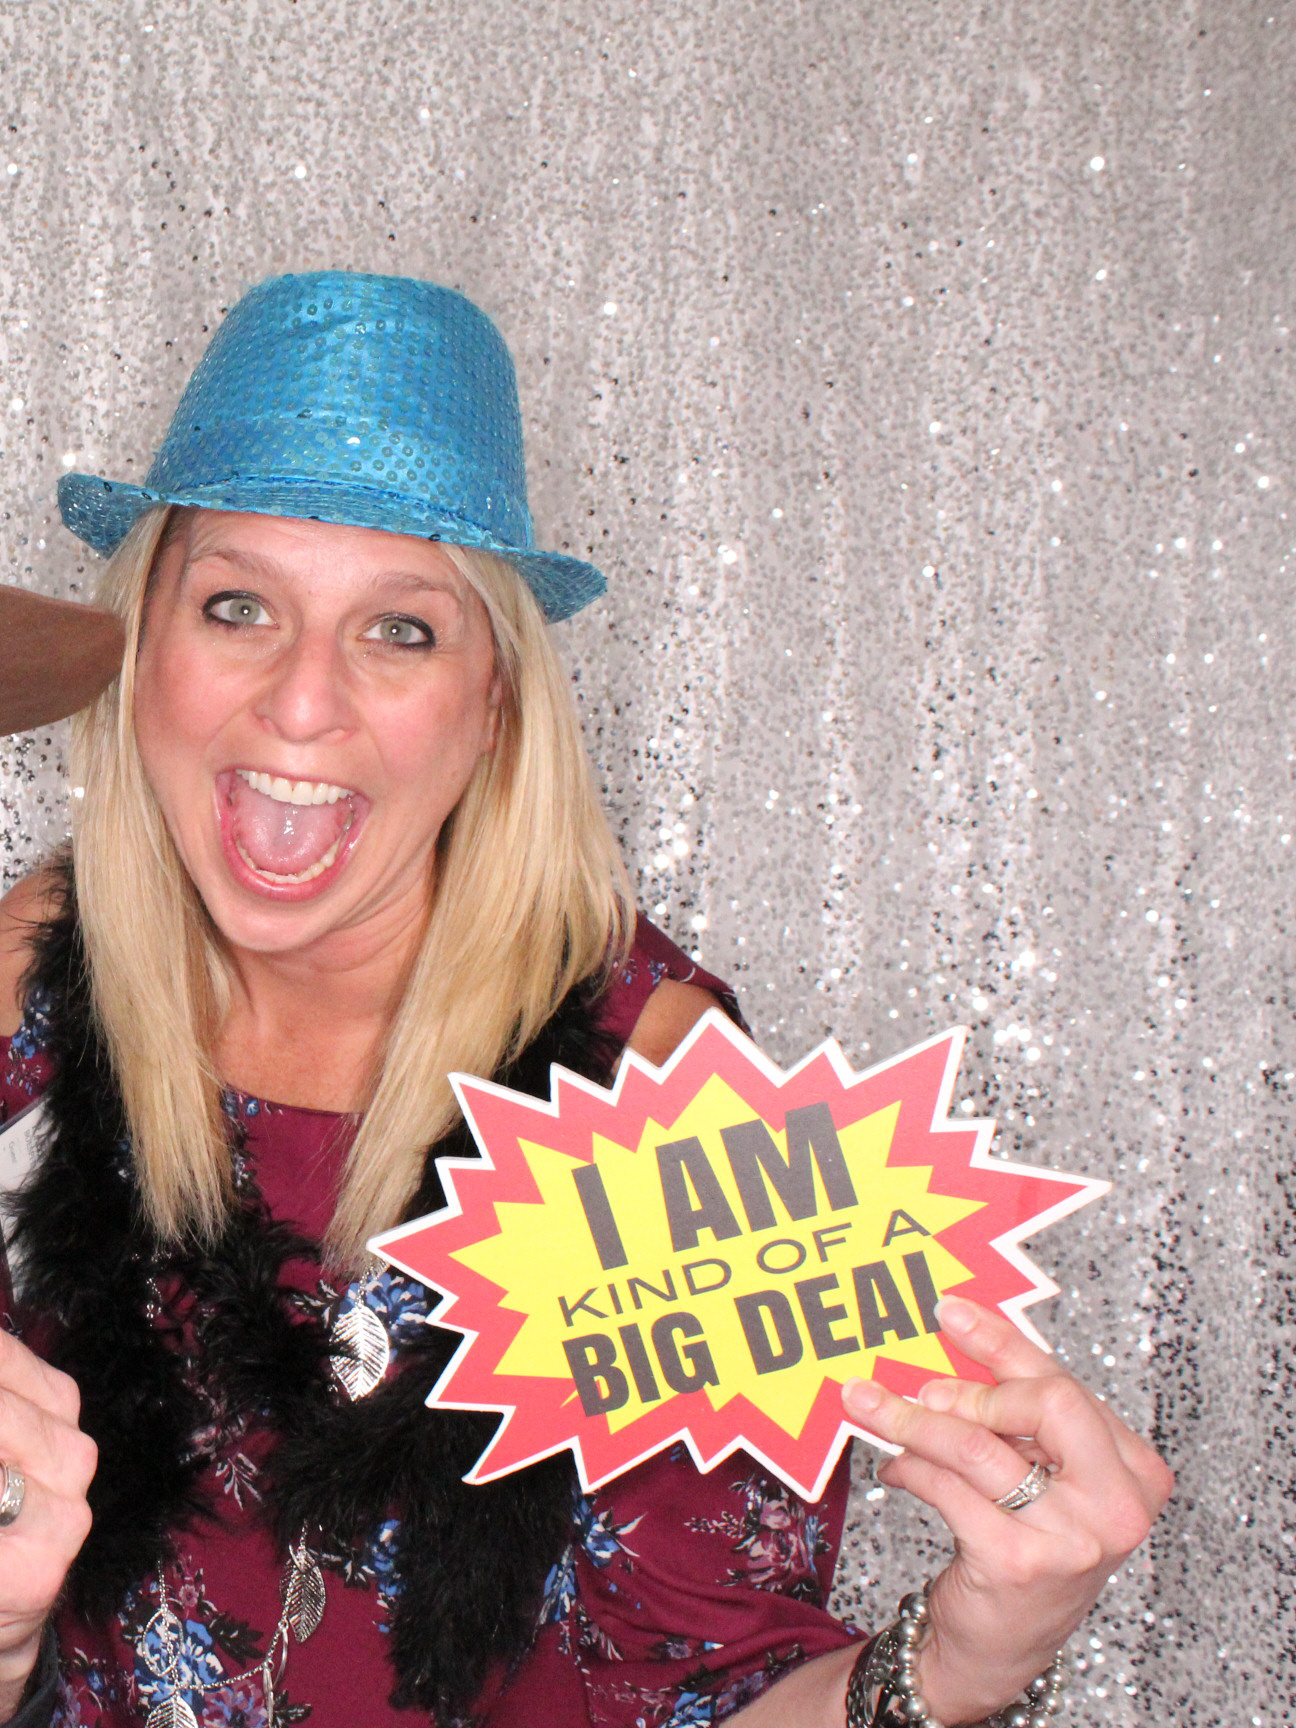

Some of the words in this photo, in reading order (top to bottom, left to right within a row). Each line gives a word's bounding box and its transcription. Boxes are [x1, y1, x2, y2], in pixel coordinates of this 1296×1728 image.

[571, 1162, 629, 1270] I
[655, 1101, 859, 1253] AM
[558, 1257, 733, 1328] KIND
[756, 1221, 853, 1275] OF
[882, 1208, 932, 1248] A
[561, 1310, 720, 1417] BIG
